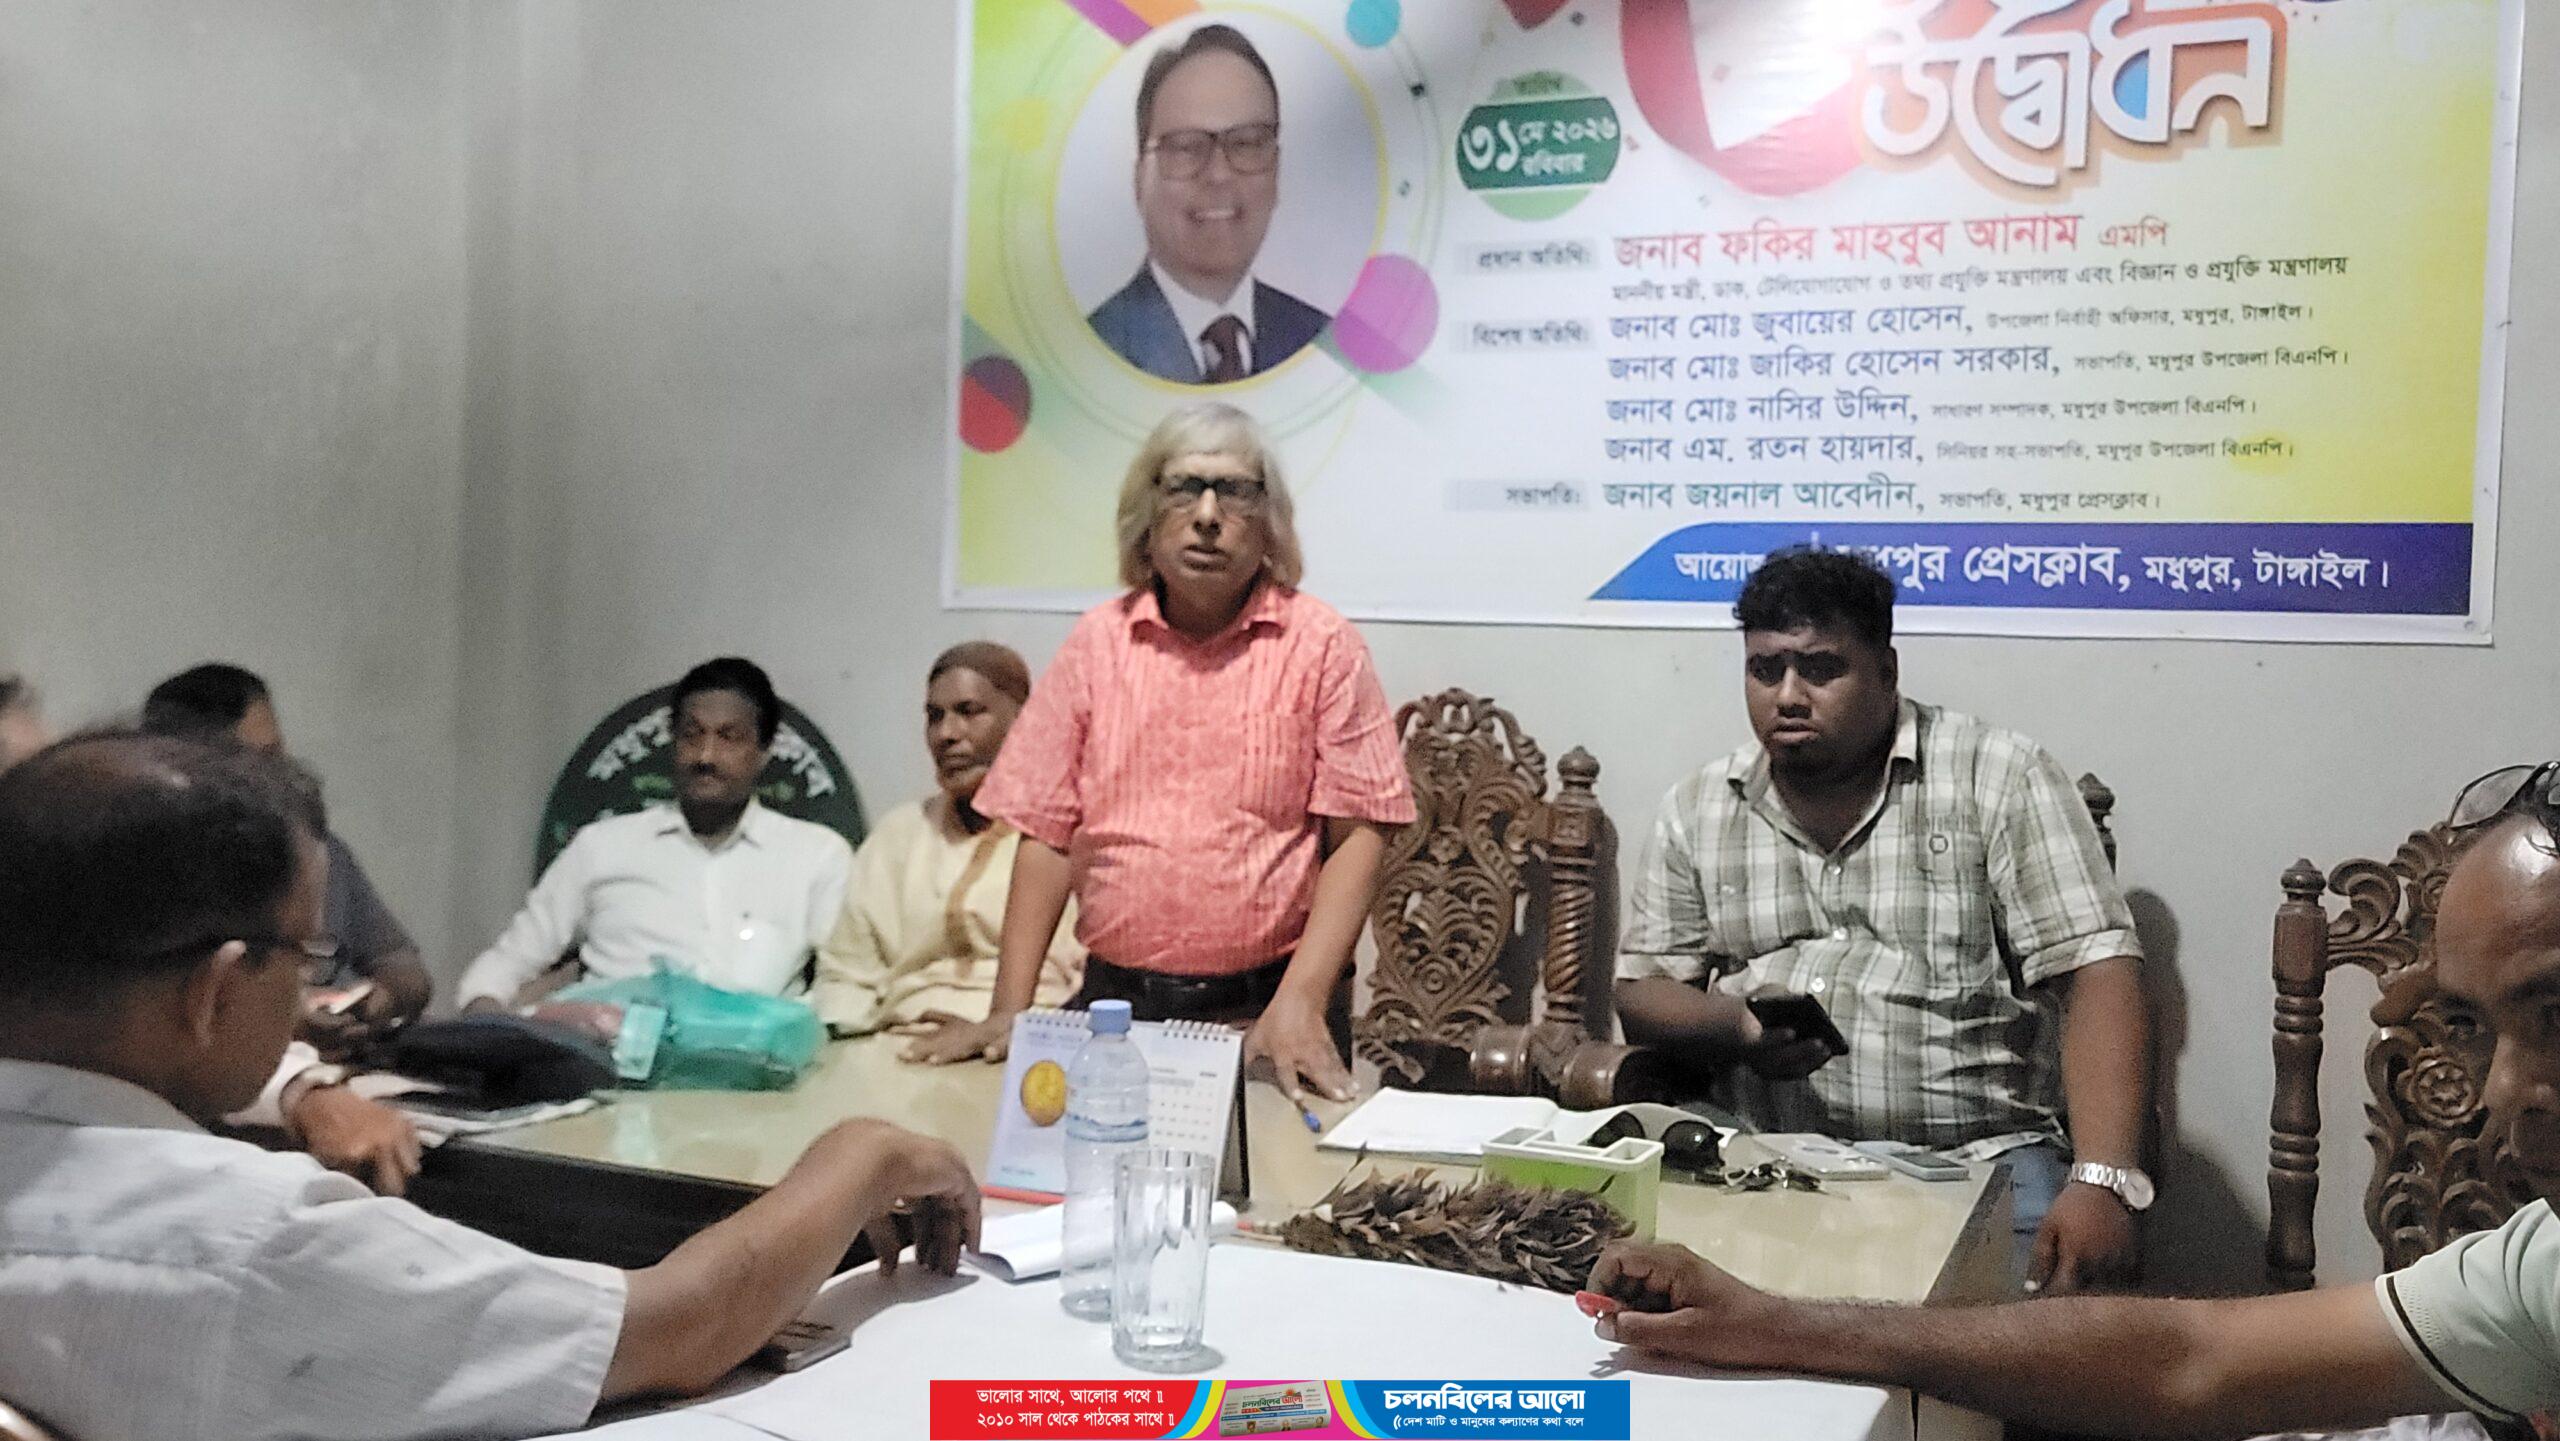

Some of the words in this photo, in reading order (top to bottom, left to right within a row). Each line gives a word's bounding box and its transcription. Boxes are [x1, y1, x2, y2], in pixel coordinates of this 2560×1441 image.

[1461, 118, 1520, 172] ৩১
[1613, 231, 1704, 269] জনাব
[1718, 217, 1817, 264] ফকির
[1831, 220, 1950, 267] মাহবুব
[1963, 212, 2083, 253] আনাম
[2098, 215, 2169, 250] এমপি
[2074, 265, 2112, 284] এবং
[2120, 259, 2177, 282] বিজ্ঞান
[2184, 263, 2198, 279] ও
[2206, 255, 2260, 283] প্রযুক্তি
[1610, 315, 1678, 341] জনাব
[1689, 313, 1741, 338] মোঃ
[1752, 310, 1856, 342] জুবায়ের
[1867, 304, 1974, 334] হোসেন,
[1608, 357, 1676, 381] জনাব
[1688, 355, 1739, 380] মোঃ
[1750, 344, 1835, 378] জাকির
[1846, 349, 1943, 379] হোসেন
[1953, 345, 2060, 376] সরকার,
[2148, 353, 2195, 372] মধুপুর
[2202, 349, 2268, 368] উপজেলা
[1606, 399, 1674, 423] জনাব
[1686, 398, 1737, 422] মোঃ
[1748, 387, 1824, 421] নাসির
[1834, 385, 1918, 422] উদ্দিন,
[2114, 398, 2178, 415] উপজেলা
[1605, 437, 1673, 462] জনাব
[1684, 437, 1734, 462] এম.
[1747, 436, 1810, 461] রতন
[1819, 433, 1924, 464] হায়দার,
[2150, 441, 2216, 458] উপজেলা
[1602, 482, 1674, 508] জনাব
[1686, 481, 1783, 508] জয়নাল
[1793, 472, 1924, 512] আবেদীন,
[2019, 492, 2071, 511] মধুপুর
[1674, 553, 1768, 582] আয়োজ
[1964, 543, 2132, 592] প্রেসক্লাব,
[2142, 555, 2242, 592] মধুপুর,
